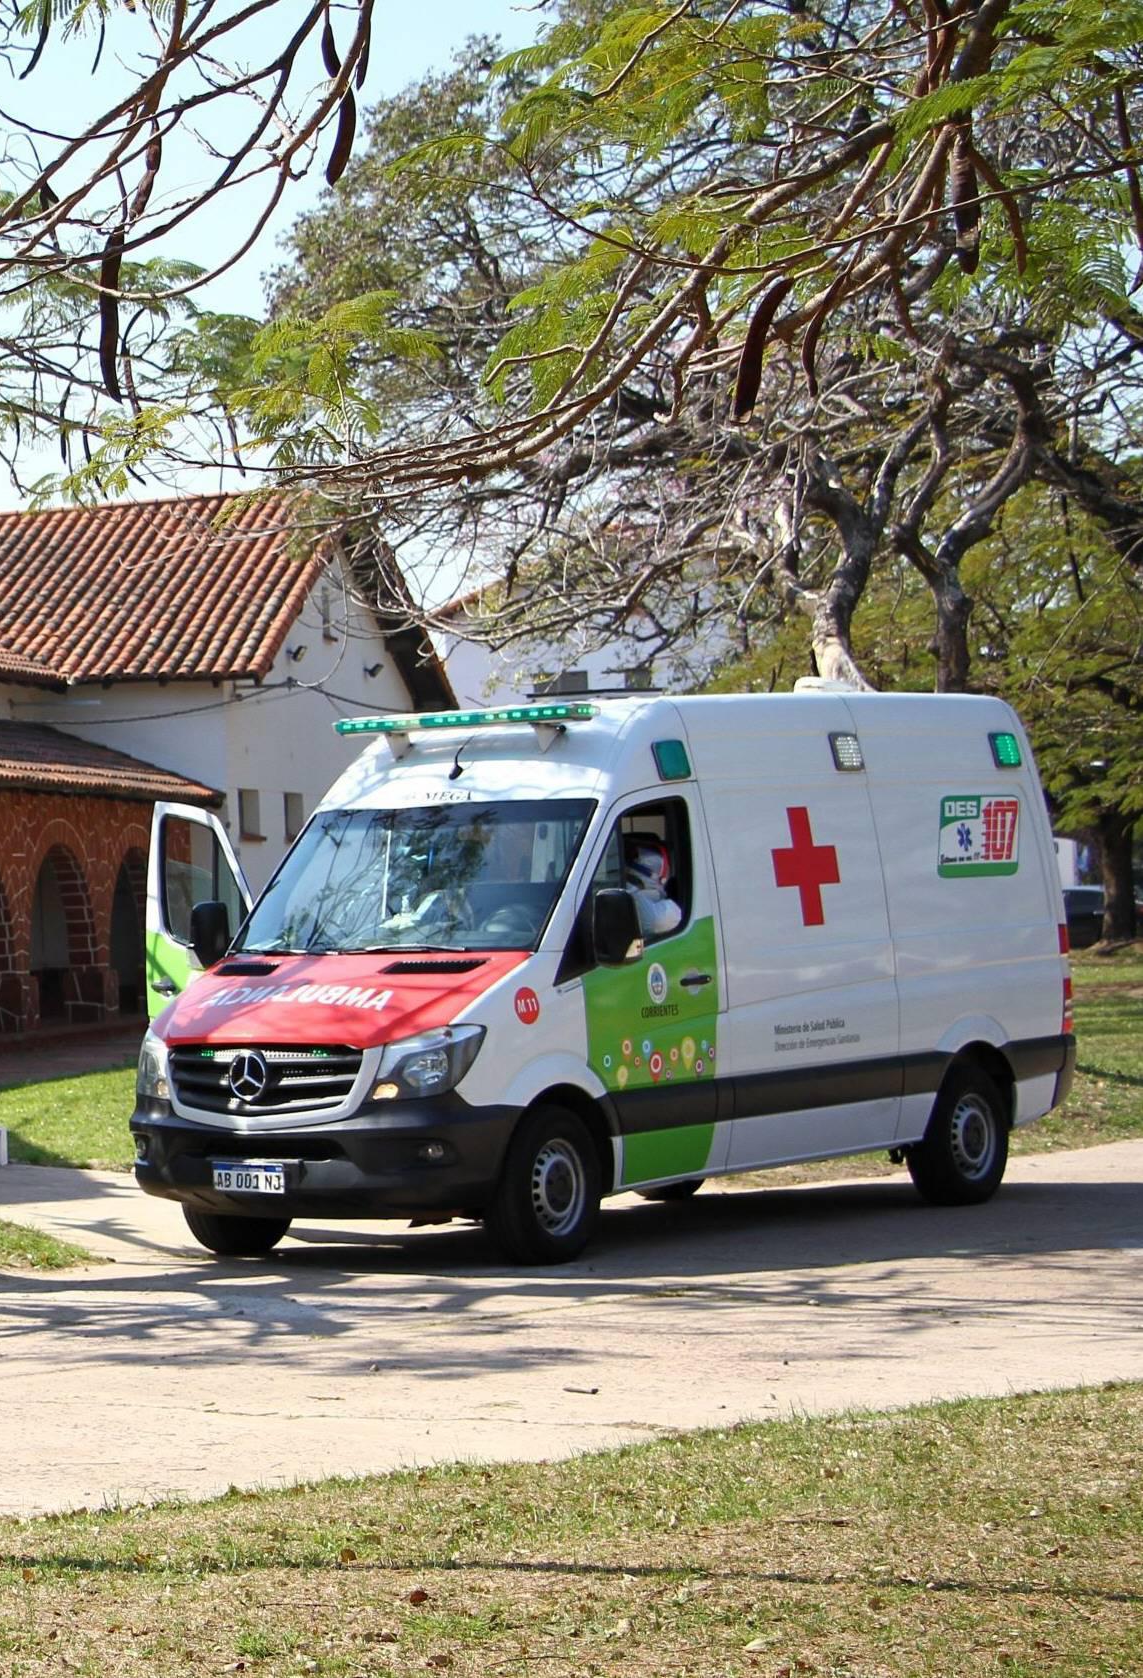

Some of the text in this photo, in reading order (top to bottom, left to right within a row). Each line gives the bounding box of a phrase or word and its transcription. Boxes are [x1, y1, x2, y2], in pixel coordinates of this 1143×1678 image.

[944, 800, 978, 817] DES
[981, 799, 1018, 861] 107
[517, 999, 527, 1013] M
[641, 1004, 679, 1018] CORRIENTES
[774, 1024, 802, 1035] Ministerio
[802, 1022, 810, 1032] de
[810, 1020, 825, 1032] Salud
[217, 1172, 281, 1191] AB 001 NJ
